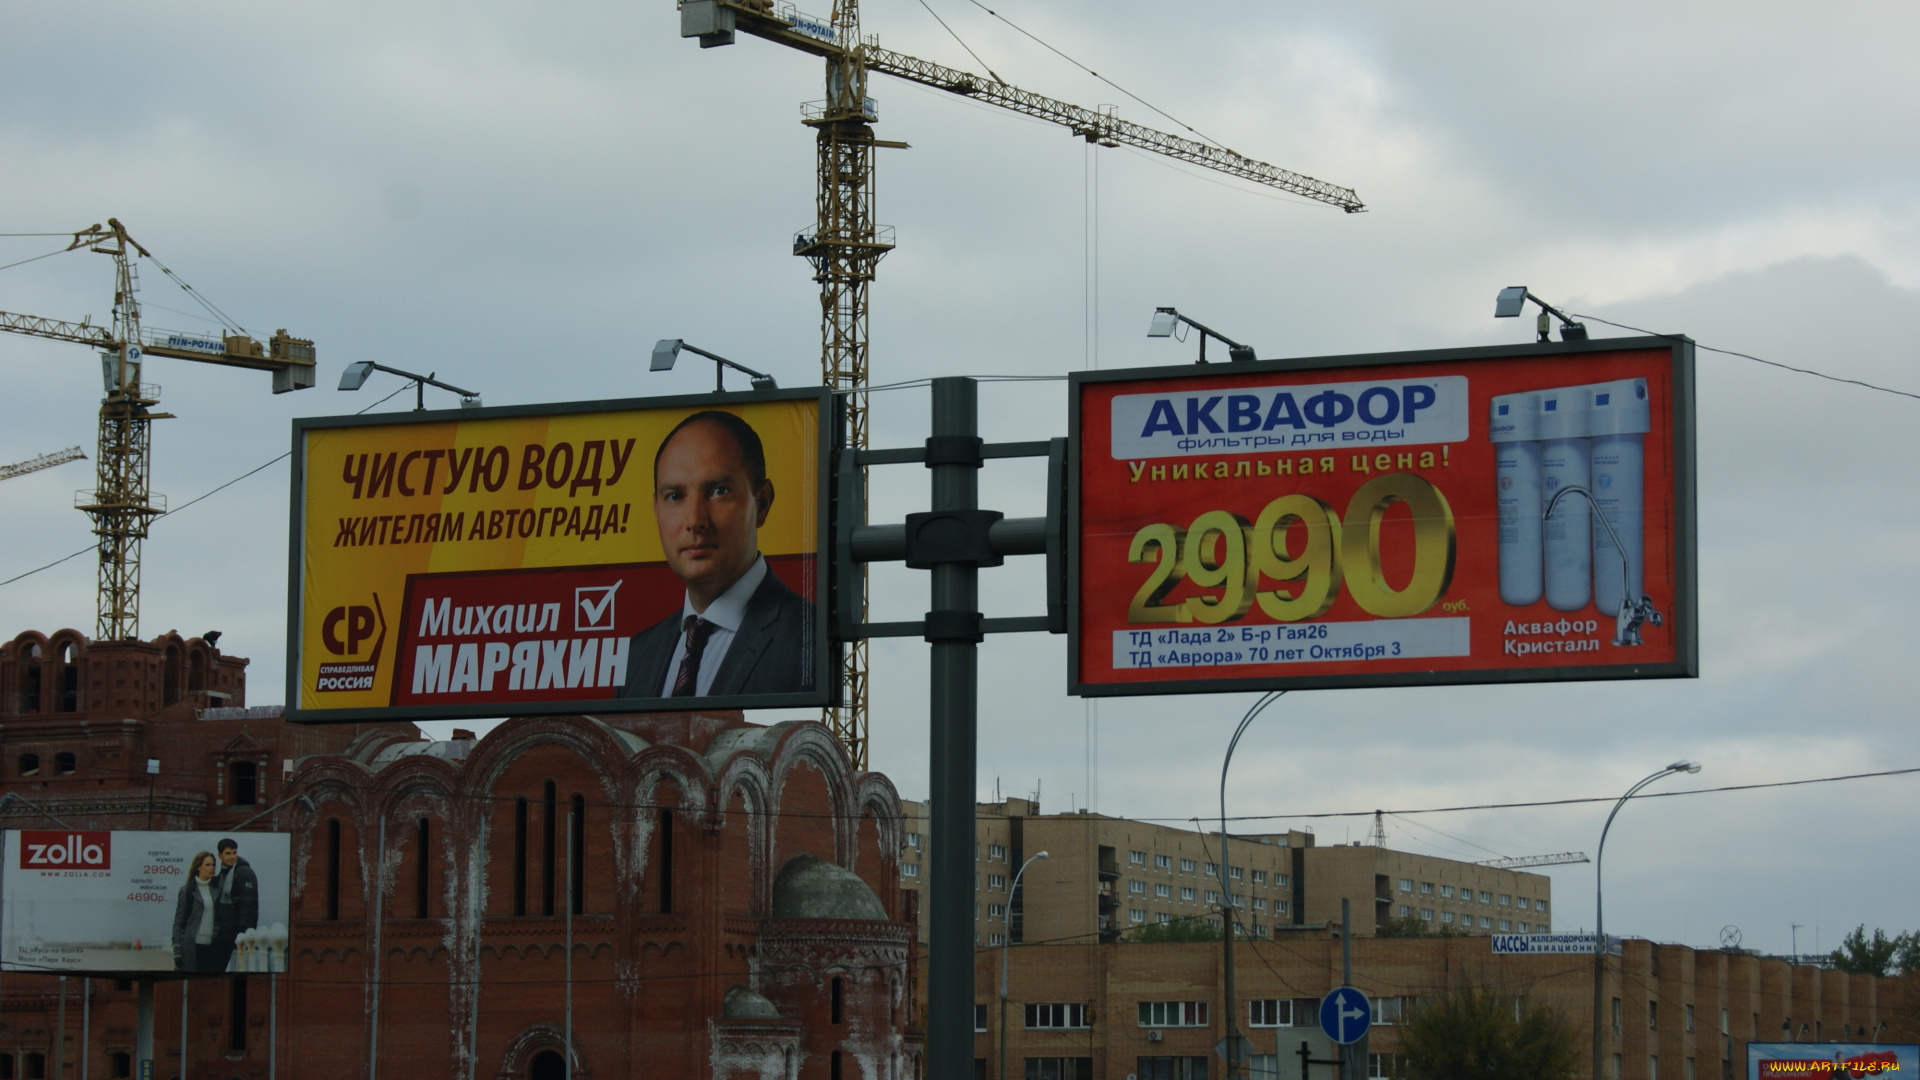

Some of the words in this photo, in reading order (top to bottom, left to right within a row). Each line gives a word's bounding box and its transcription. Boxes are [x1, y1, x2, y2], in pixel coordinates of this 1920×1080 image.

[168, 336, 225, 351] MIN-POTAIN
[1140, 384, 1437, 438] АКВАФОР
[1177, 433, 1286, 452] фильтры
[1291, 431, 1335, 446] для
[1342, 428, 1405, 443] воды
[342, 445, 510, 500] ЧИСТУЮ
[516, 438, 637, 500] ВОДУ
[1128, 455, 1336, 483] Уникальная
[1352, 444, 1451, 475] цена!
[333, 510, 465, 548] ЖИТЕЛЯМ
[468, 502, 631, 542] АВТОГРАДА!
[1127, 472, 1456, 626] 2990
[418, 597, 561, 637] Михаил
[1503, 617, 1598, 636] Аквафор
[321, 604, 376, 656] СР
[1129, 631, 1152, 646] ТД
[1157, 629, 1215, 645] «Лада
[1216, 628, 1236, 643] 2»
[1241, 627, 1271, 643] Б-р
[1129, 651, 1152, 666] ТД
[1157, 648, 1243, 666] «Аврора»
[1248, 646, 1269, 661] 70
[1273, 647, 1305, 661] лет
[1309, 642, 1386, 661] Октября
[1390, 641, 1402, 656] 3
[1504, 639, 1600, 657] Кристалл
[320, 664, 375, 674] СПРАВЕДЛИВАЯ
[410, 636, 631, 695] МАРЯХИН
[317, 676, 374, 690] РОССИЯ
[28, 834, 103, 865] zolla
[1492, 935, 1529, 953] КАССЫ
[1530, 935, 1606, 944] ЖЕЛЕЗНОДОРОЖНЕ
